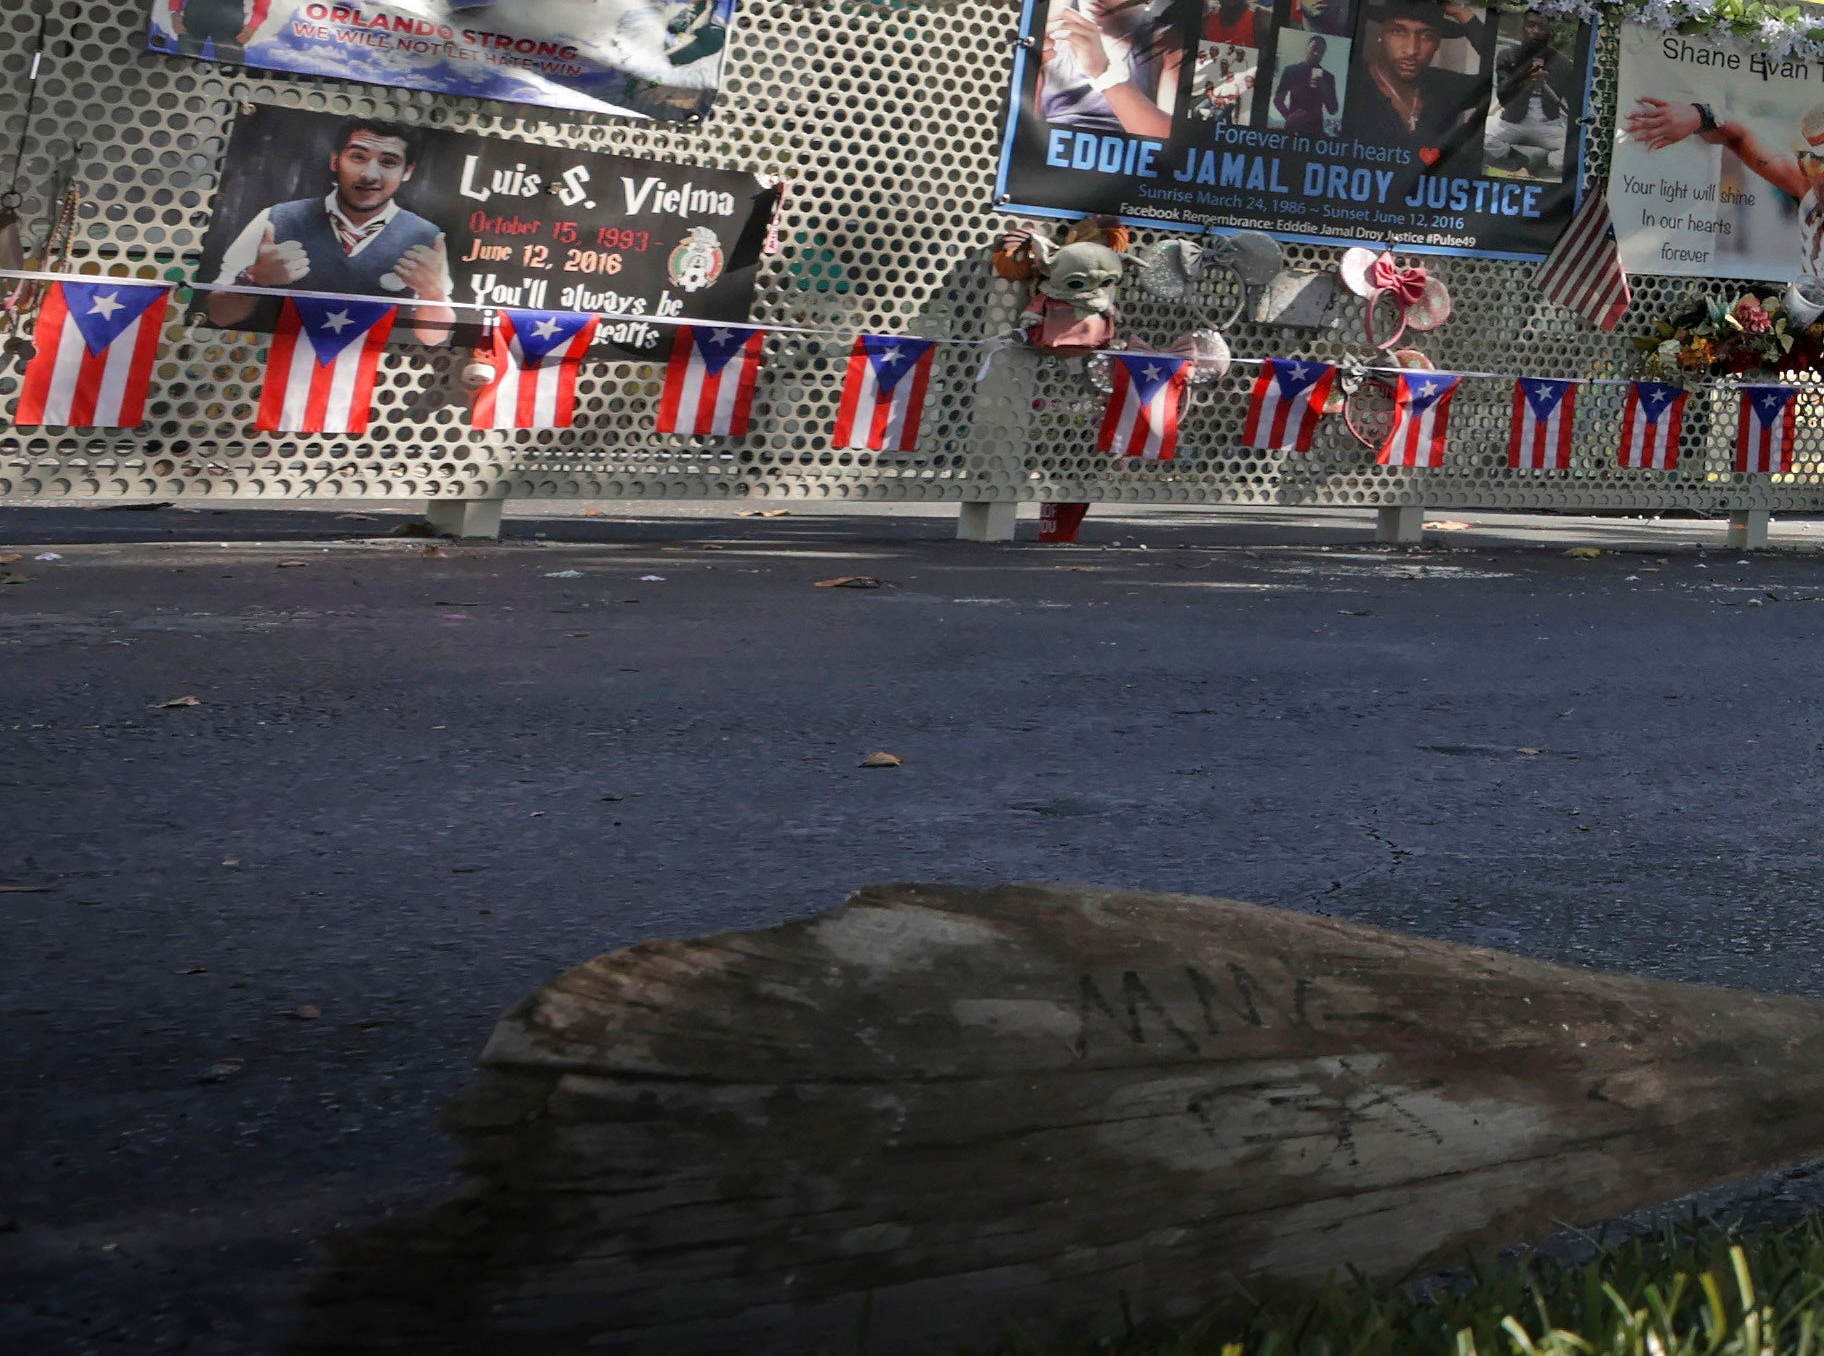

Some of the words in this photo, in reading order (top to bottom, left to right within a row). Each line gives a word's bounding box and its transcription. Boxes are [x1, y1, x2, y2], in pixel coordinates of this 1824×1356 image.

[291, 21, 329, 40] WE
[335, 26, 390, 49] WILL
[398, 39, 444, 56] NOT
[449, 45, 479, 62] LET
[484, 52, 532, 71] HATE
[540, 60, 584, 77] WIN
[306, 2, 455, 40] ORLANDO
[462, 29, 579, 61] STRONG
[1662, 36, 1742, 71] Shane
[1749, 54, 1809, 81] Evan
[1214, 121, 1289, 149] Forever
[1292, 132, 1311, 153] in
[1315, 138, 1349, 158] our
[1353, 140, 1412, 165] hearts
[459, 155, 543, 202] Luis
[558, 164, 597, 210] S.
[620, 175, 735, 219] Vielma
[1046, 128, 1163, 179] EDDIE
[1173, 147, 1289, 194] JAMAL
[1303, 162, 1394, 204] DROY
[1405, 174, 1544, 218] JUSTICE
[1622, 173, 1656, 196] Your
[1659, 178, 1689, 206] light
[1692, 181, 1716, 203] will
[1720, 185, 1757, 206] shine
[469, 210, 542, 236] October
[552, 220, 583, 245] 15,
[1119, 202, 1181, 221] Facebook
[1182, 209, 1275, 231] Remembrance:
[1276, 219, 1319, 235] Edddie
[1319, 222, 1355, 238] Jamal
[1356, 225, 1385, 243] Droy
[1385, 229, 1425, 244] Justice
[1426, 232, 1477, 248] #Pulse49
[1138, 183, 1193, 204] Sunrise
[1196, 190, 1244, 209] March
[1247, 196, 1268, 213] 24,
[1323, 204, 1370, 222] Sunset
[1373, 209, 1405, 225] June
[1409, 213, 1428, 229] 12,
[1432, 215, 1466, 230] 2016
[1641, 208, 1656, 227] In
[1659, 215, 1684, 231] our
[1687, 212, 1732, 236] hearts
[461, 238, 513, 262] June
[522, 243, 554, 271] 12,
[563, 249, 623, 276] 2016
[1660, 241, 1711, 263] forever
[470, 273, 549, 311] You'll
[560, 283, 647, 316] always
[654, 290, 684, 317] be
